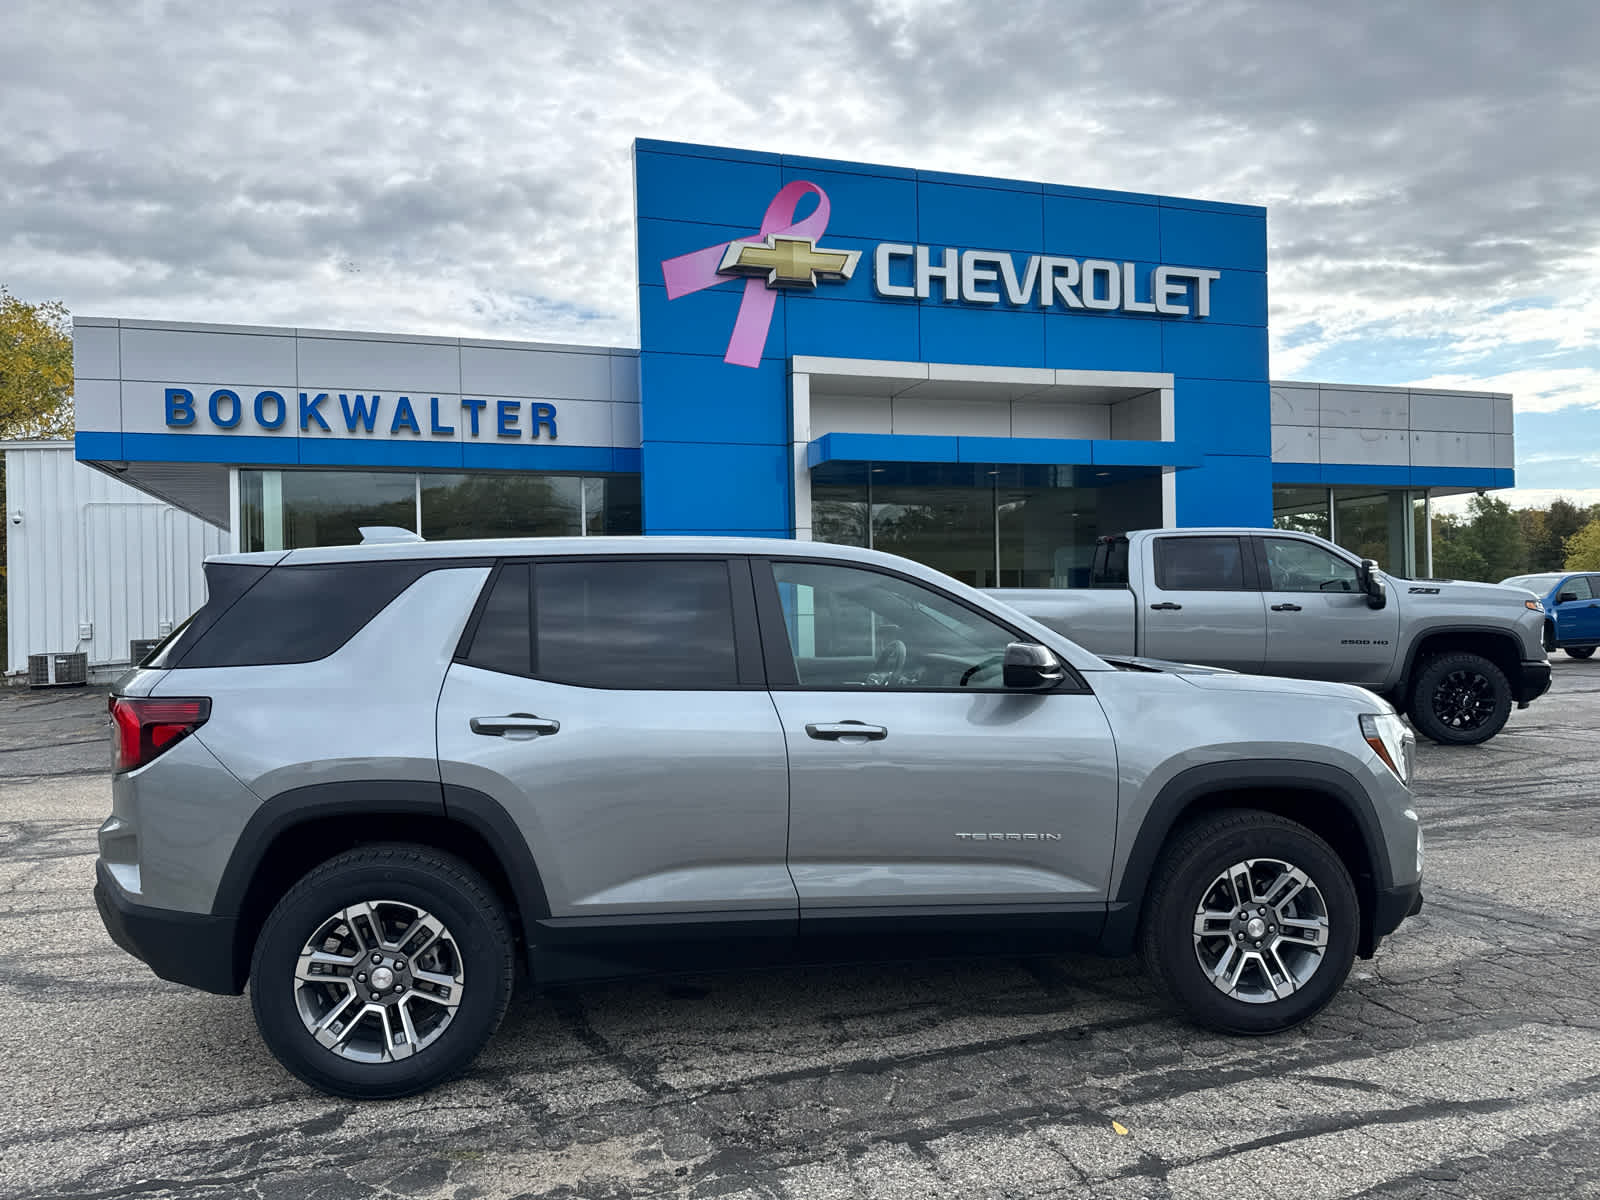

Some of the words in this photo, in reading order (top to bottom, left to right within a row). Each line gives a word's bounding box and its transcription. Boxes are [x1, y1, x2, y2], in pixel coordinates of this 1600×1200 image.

[874, 242, 1221, 318] CHEVROLET
[164, 387, 558, 439] BOOKWALTER
[955, 832, 1062, 841] TERRAIN
